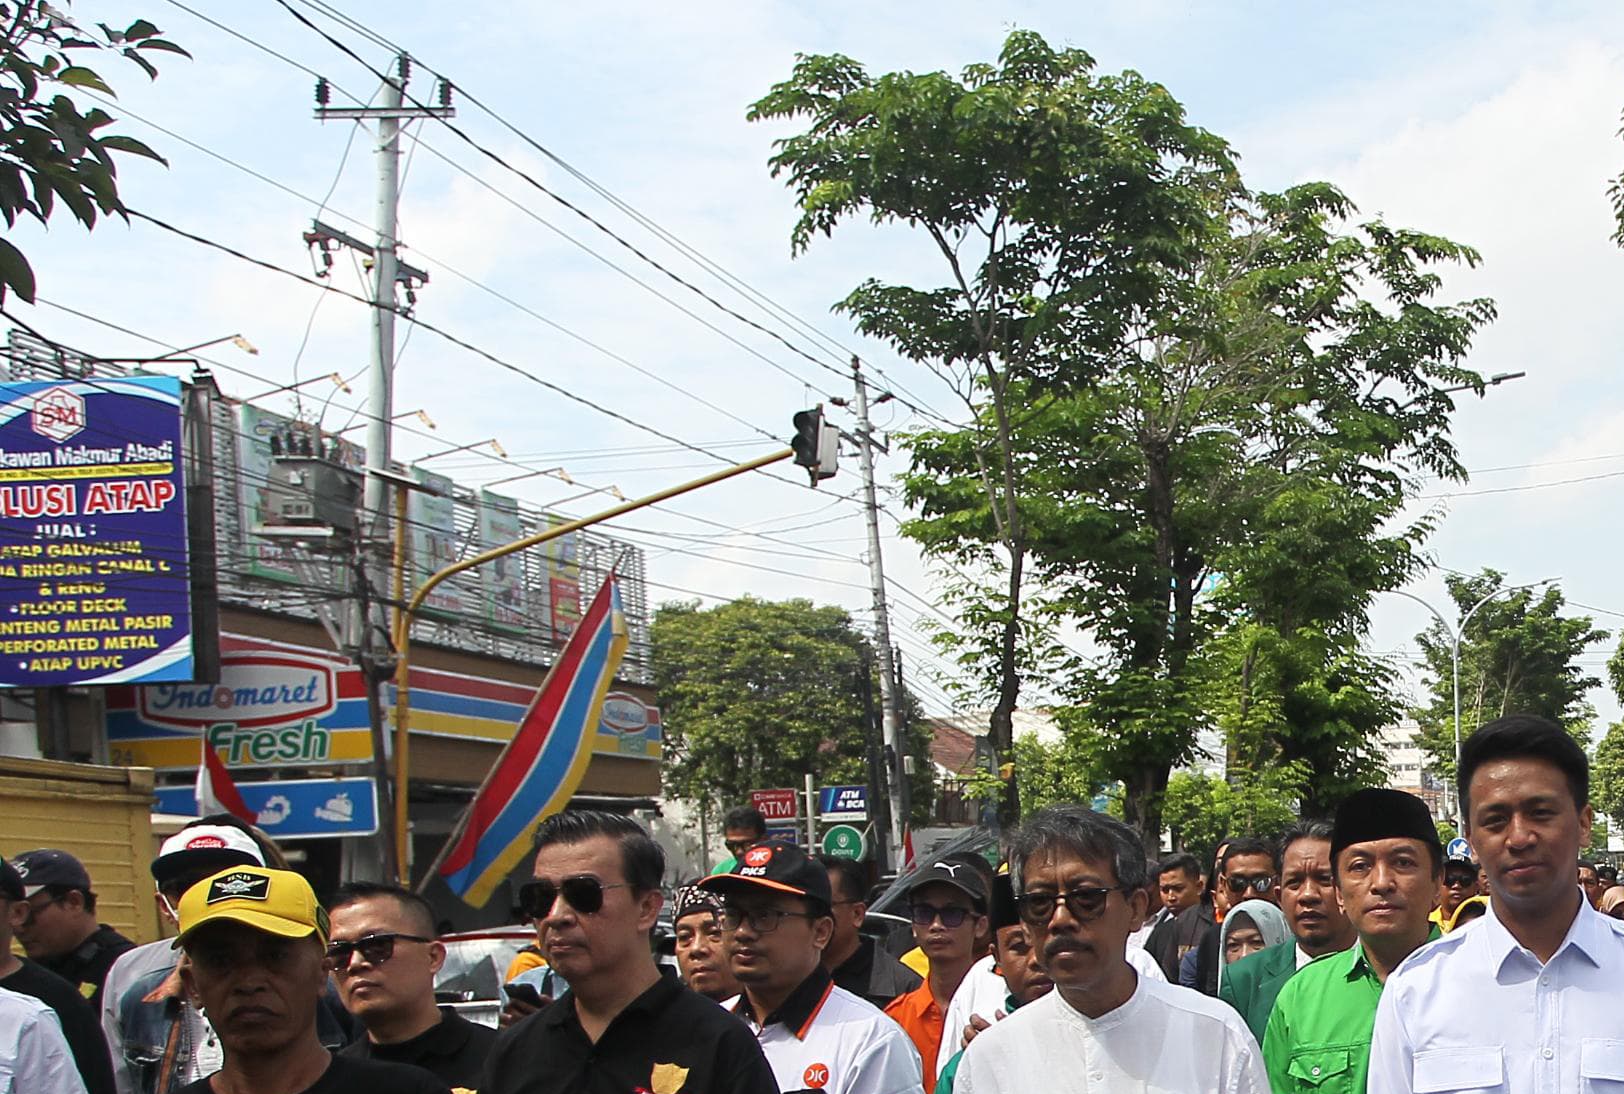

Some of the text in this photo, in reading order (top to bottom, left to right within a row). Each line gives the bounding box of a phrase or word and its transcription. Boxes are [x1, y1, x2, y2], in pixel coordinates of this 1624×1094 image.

[55, 444, 122, 465] Makmur
[125, 440, 173, 461] Abadi
[2, 480, 175, 517] LUSI ATAP
[22, 562, 92, 577] RINGAN
[20, 598, 127, 615] FLOOR DECK
[0, 615, 173, 635] NTENG METAL PASIR
[104, 635, 159, 650] METAL
[29, 656, 124, 672] ATAP UPVC
[153, 676, 323, 711] Indomaret
[207, 718, 329, 764] Fresh
[840, 790, 860, 799] ATM
[758, 801, 792, 816] ATM
[740, 866, 766, 876] PKS
